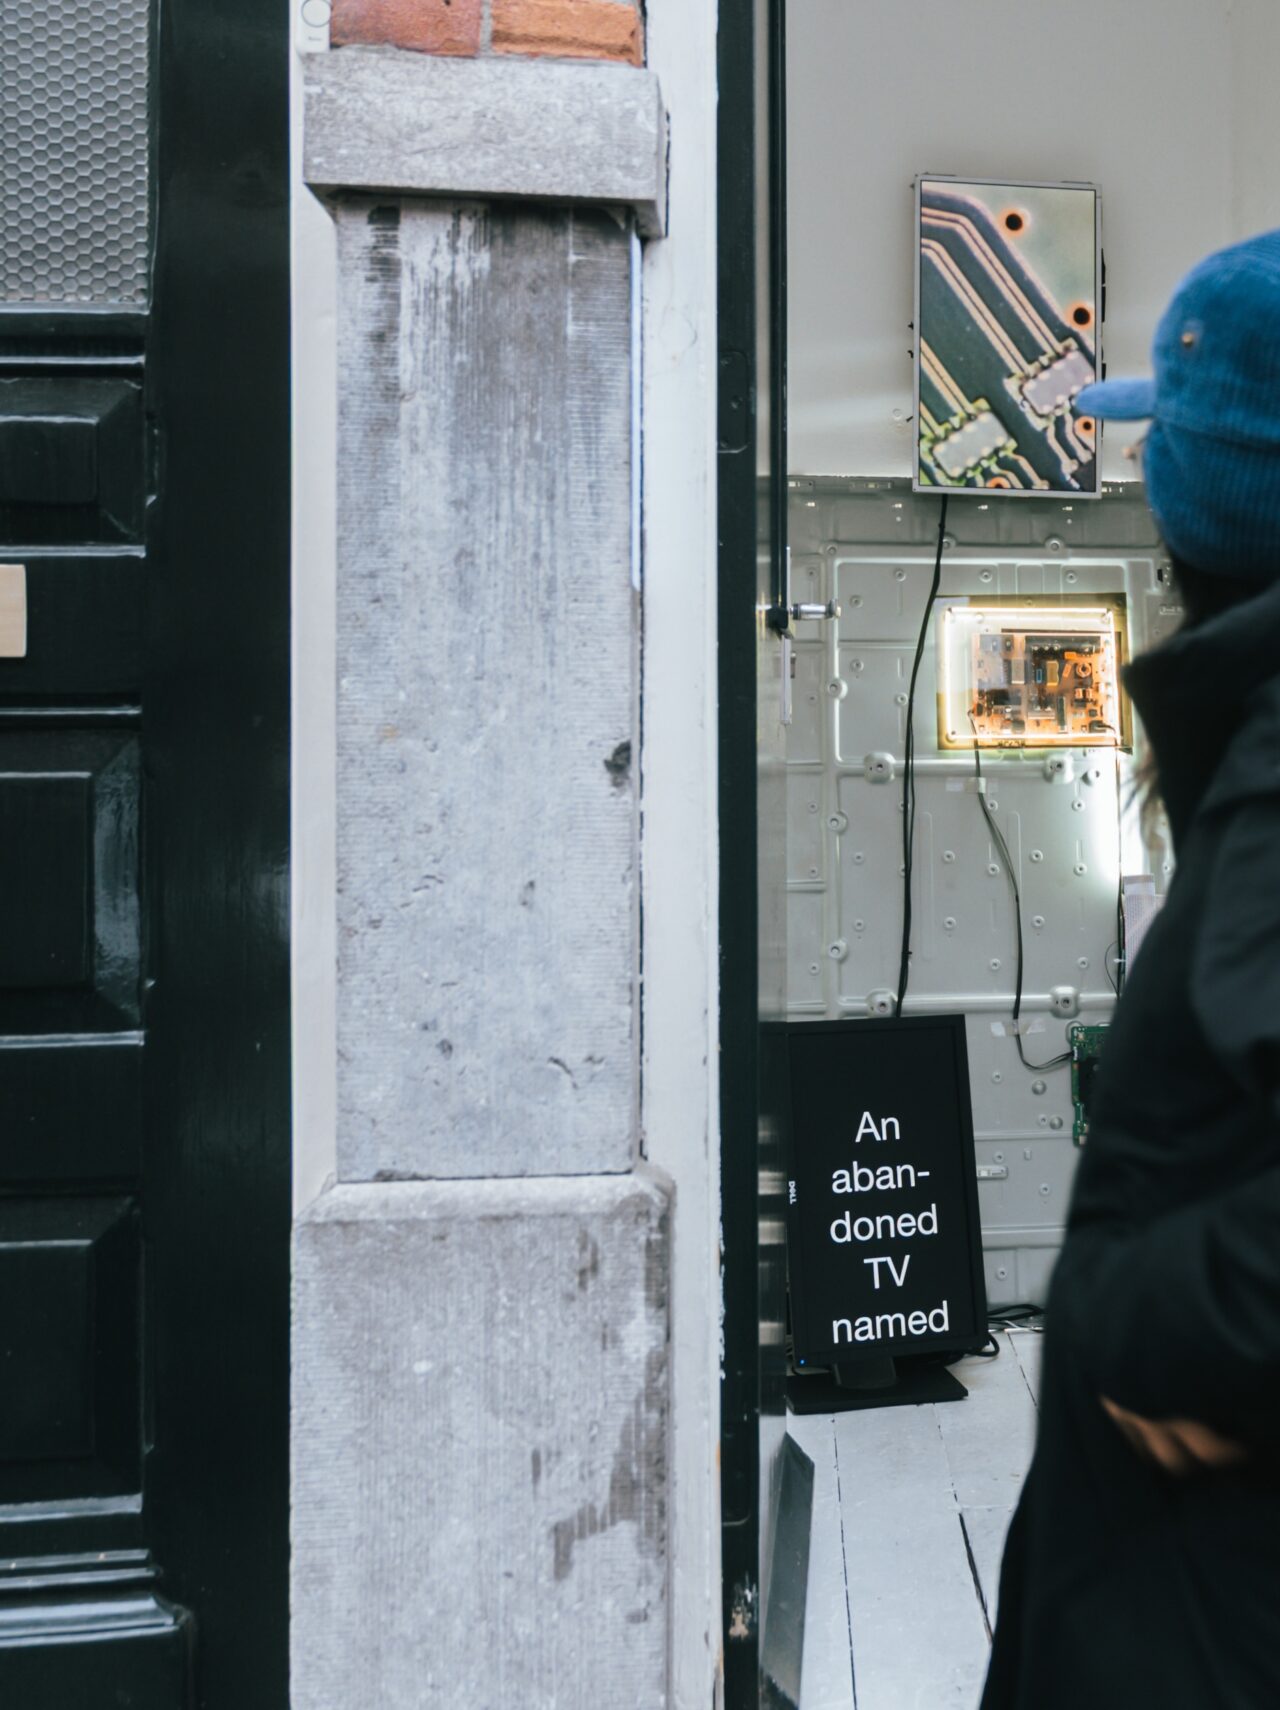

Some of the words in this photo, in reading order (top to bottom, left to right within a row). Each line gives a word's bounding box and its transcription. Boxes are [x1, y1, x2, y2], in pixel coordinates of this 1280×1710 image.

[854, 1111, 900, 1142] An
[788, 1180, 797, 1205] DELL
[831, 1161, 929, 1193] aban-
[829, 1203, 938, 1243] doned
[863, 1255, 911, 1289] TV
[833, 1300, 949, 1343] named
